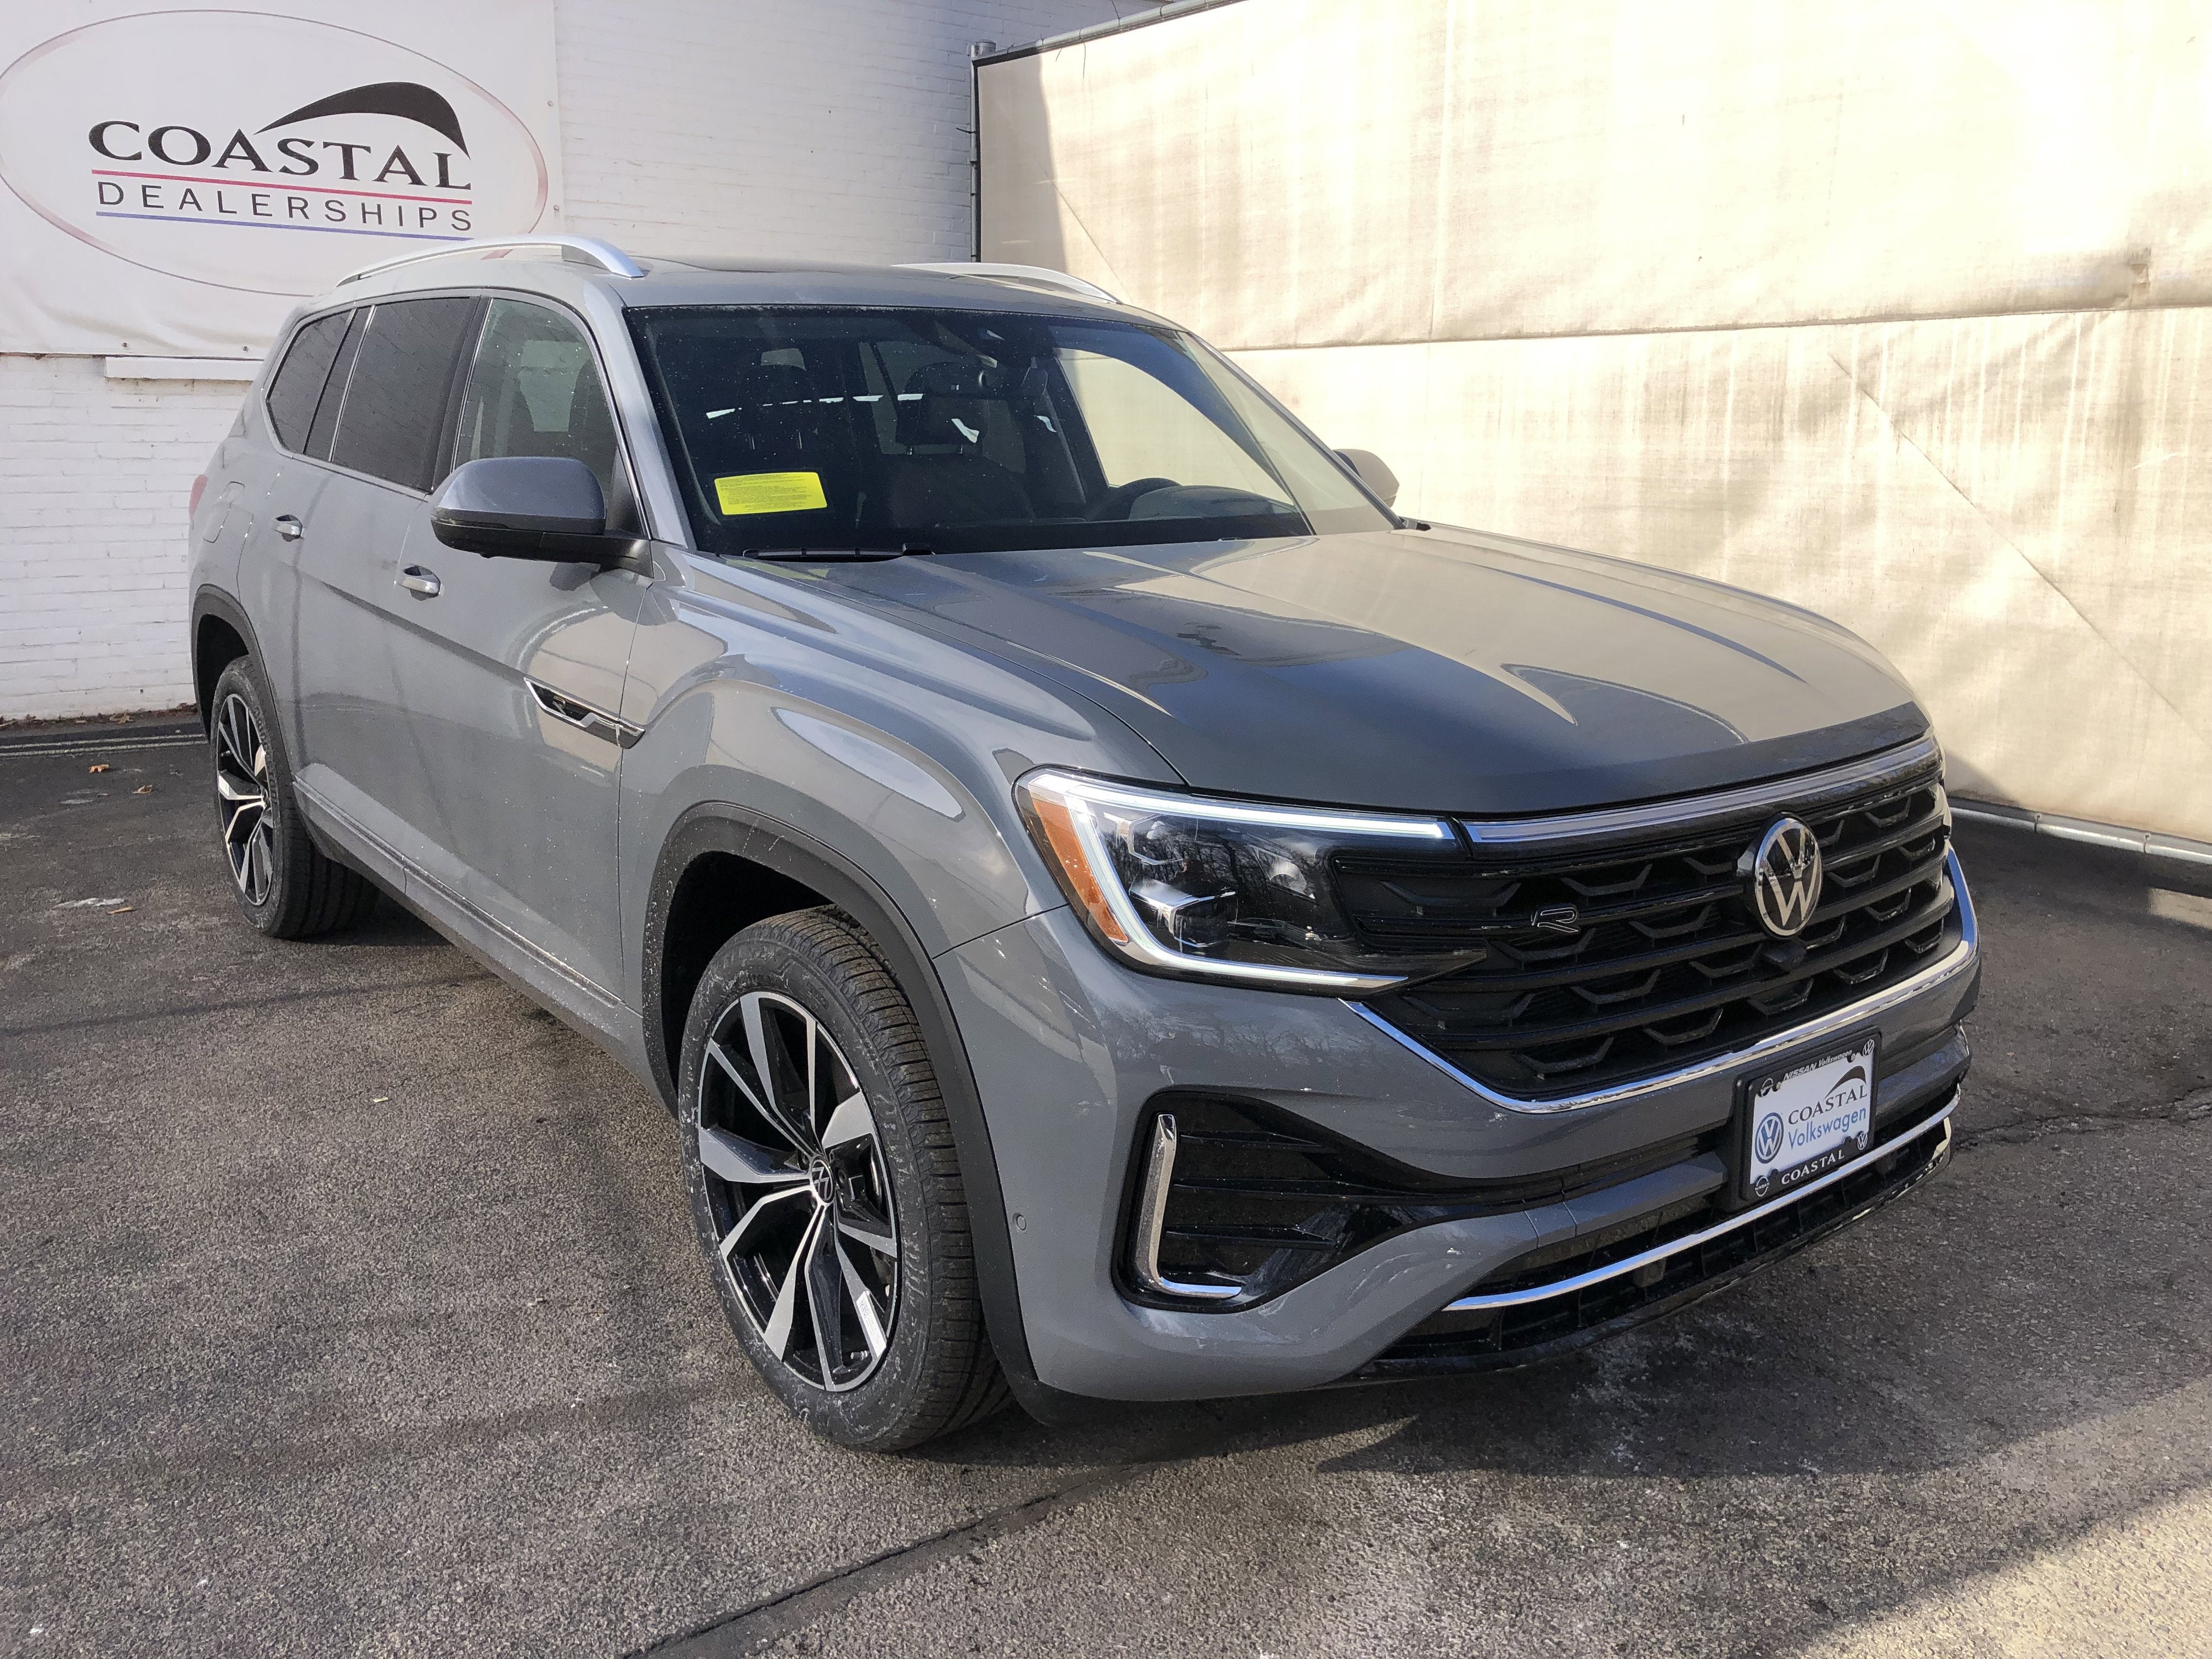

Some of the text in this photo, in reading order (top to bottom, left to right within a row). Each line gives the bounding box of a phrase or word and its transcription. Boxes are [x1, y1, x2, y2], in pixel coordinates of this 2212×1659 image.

[89, 120, 471, 190] COASTAL
[99, 181, 472, 232] DEALERSHIPS
[1759, 821, 1820, 930] VW
[1537, 907, 1579, 933] R
[1784, 1063, 1817, 1081] NISSAN
[1787, 1084, 1867, 1125] COASTAL
[1756, 1114, 1783, 1163] VW
[1788, 1107, 1866, 1150] Volkswagen
[1781, 1149, 1844, 1184] COASTAL
